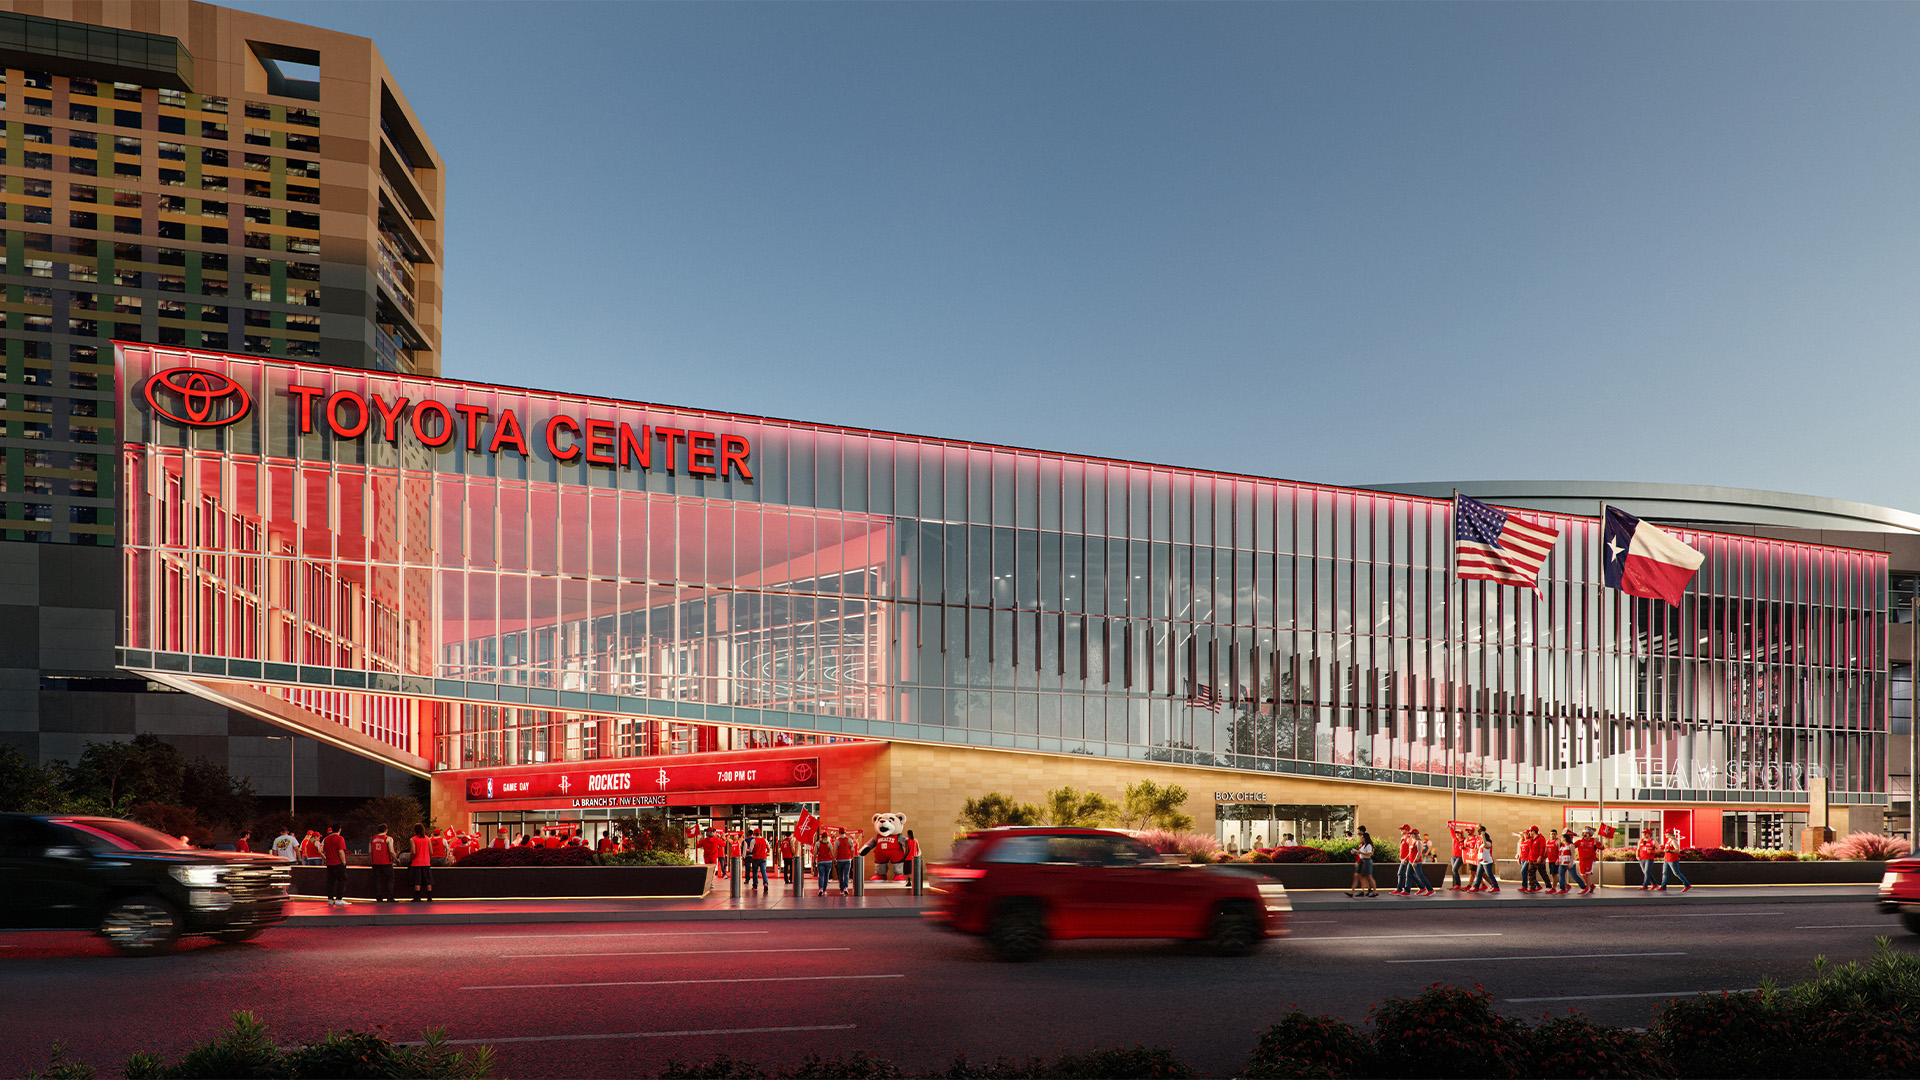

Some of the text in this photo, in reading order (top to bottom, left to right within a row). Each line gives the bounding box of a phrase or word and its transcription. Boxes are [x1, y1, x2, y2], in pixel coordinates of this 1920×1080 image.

[288, 384, 753, 480] TOYOTA CENTER
[717, 770, 756, 782] 7:00 PM CT
[1628, 757, 1716, 789] TEAM
[503, 782, 530, 792] GAME DAY
[588, 773, 631, 791] ROCKETS
[572, 796, 667, 807] LA BRANCH ST. NW ENTRANCE
[1215, 792, 1267, 801] BOX OFFICE
